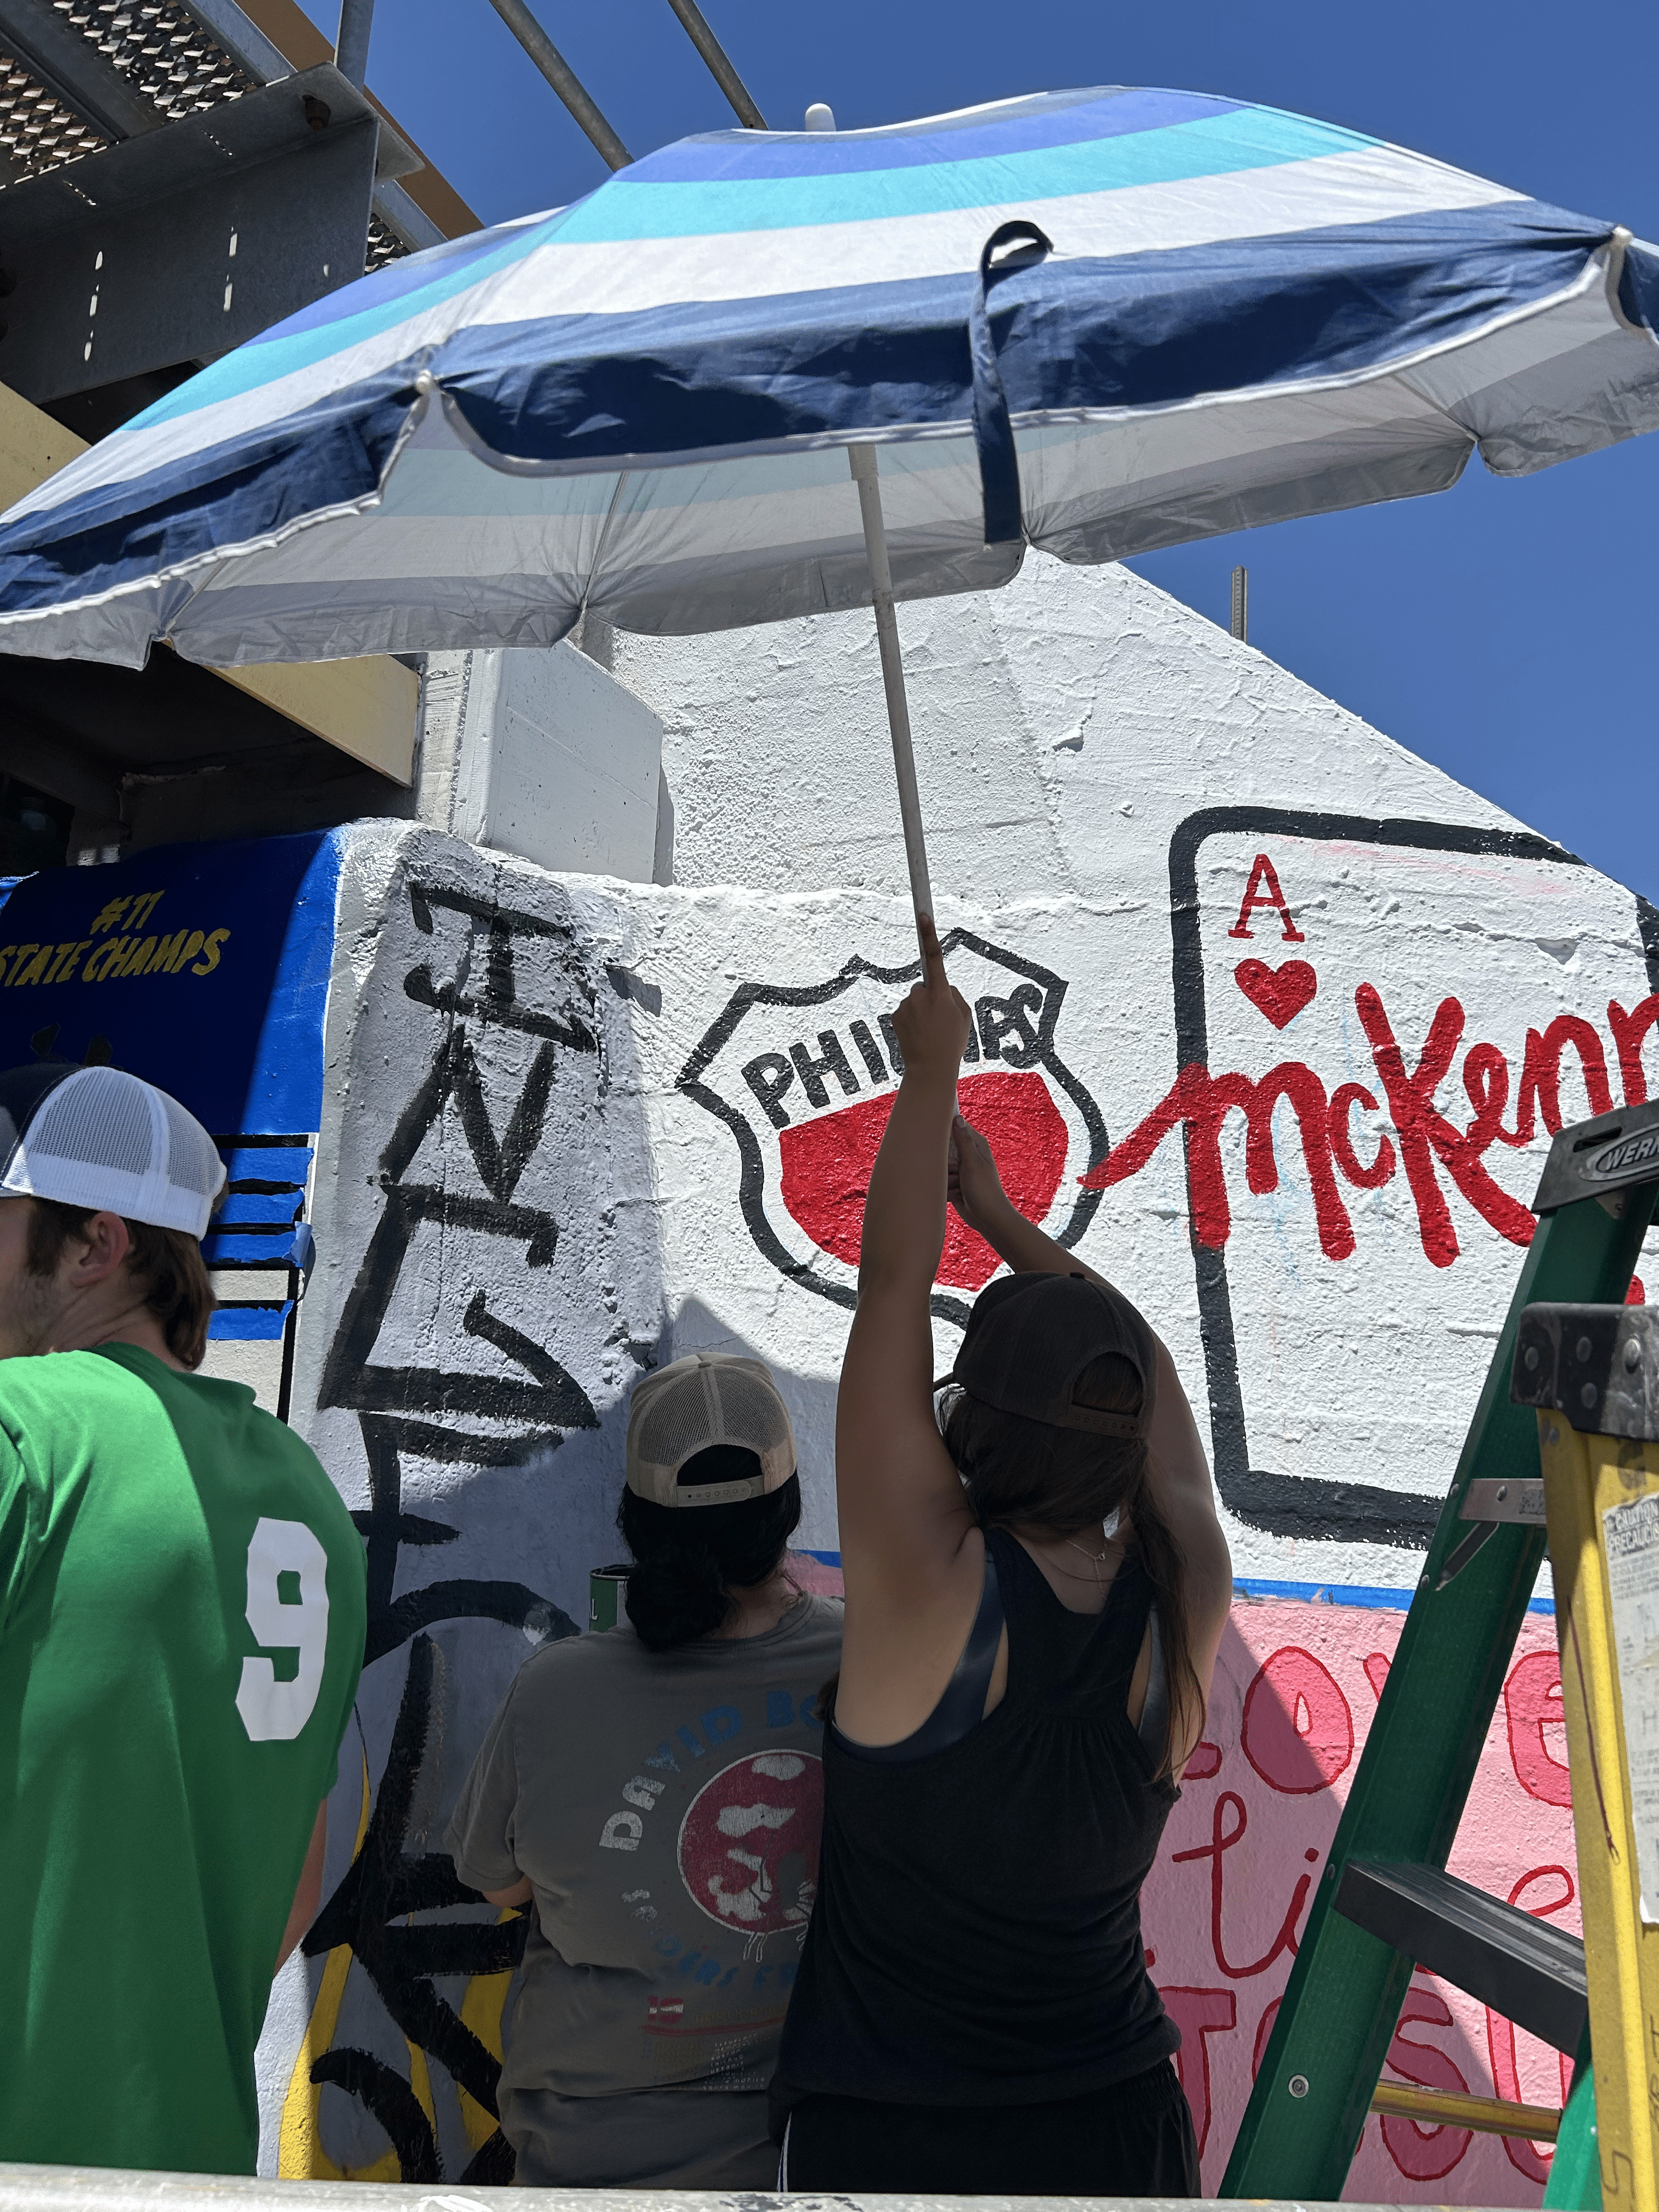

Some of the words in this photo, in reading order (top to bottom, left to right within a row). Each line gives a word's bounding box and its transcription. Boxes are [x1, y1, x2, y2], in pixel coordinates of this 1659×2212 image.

[90, 889, 165, 934] #11
[1227, 853, 1305, 942] A
[0, 939, 93, 987] STATE
[81, 927, 232, 983] CHAMPS
[235, 1517, 330, 1741] 9
[599, 1705, 742, 1853] DAVID
